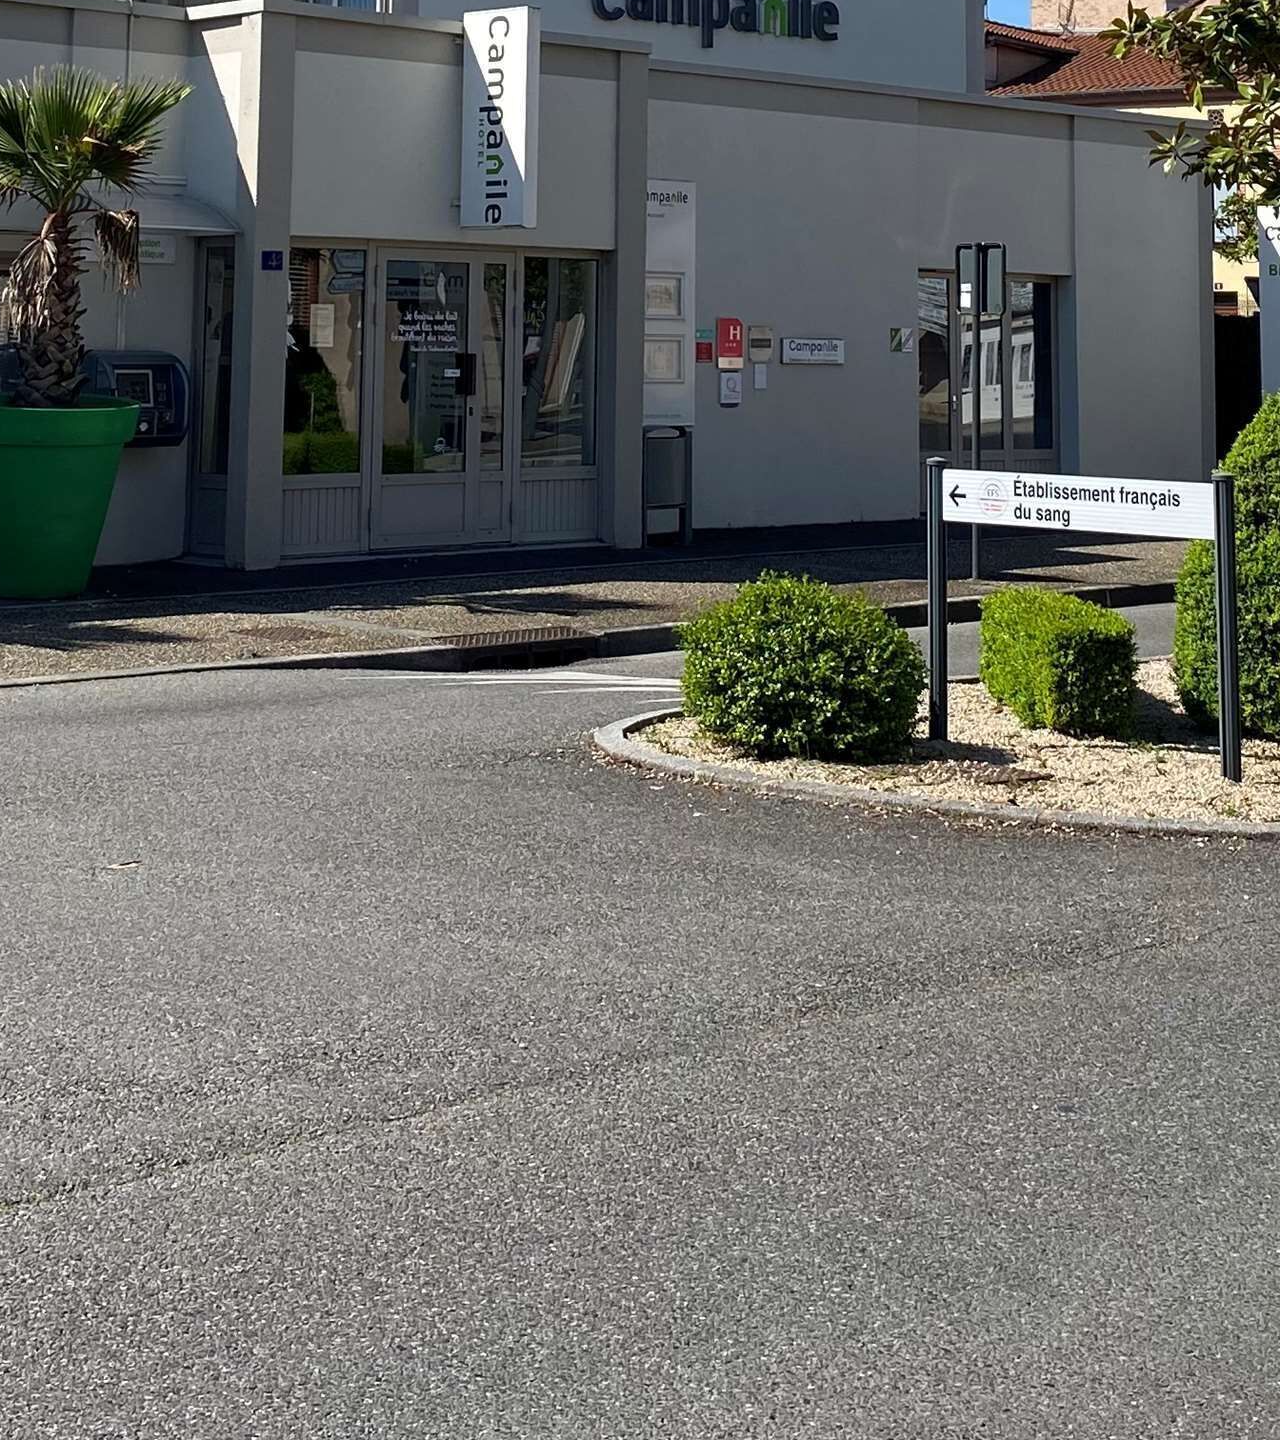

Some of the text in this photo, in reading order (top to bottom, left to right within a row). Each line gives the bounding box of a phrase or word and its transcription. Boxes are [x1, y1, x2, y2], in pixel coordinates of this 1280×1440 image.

[479, 15, 510, 225] Campanile
[729, 325, 741, 341] H
[788, 339, 839, 357] Campanile
[1013, 474, 1181, 511] Établissement français
[1013, 502, 1031, 520] du
[1035, 507, 1070, 527] sang
